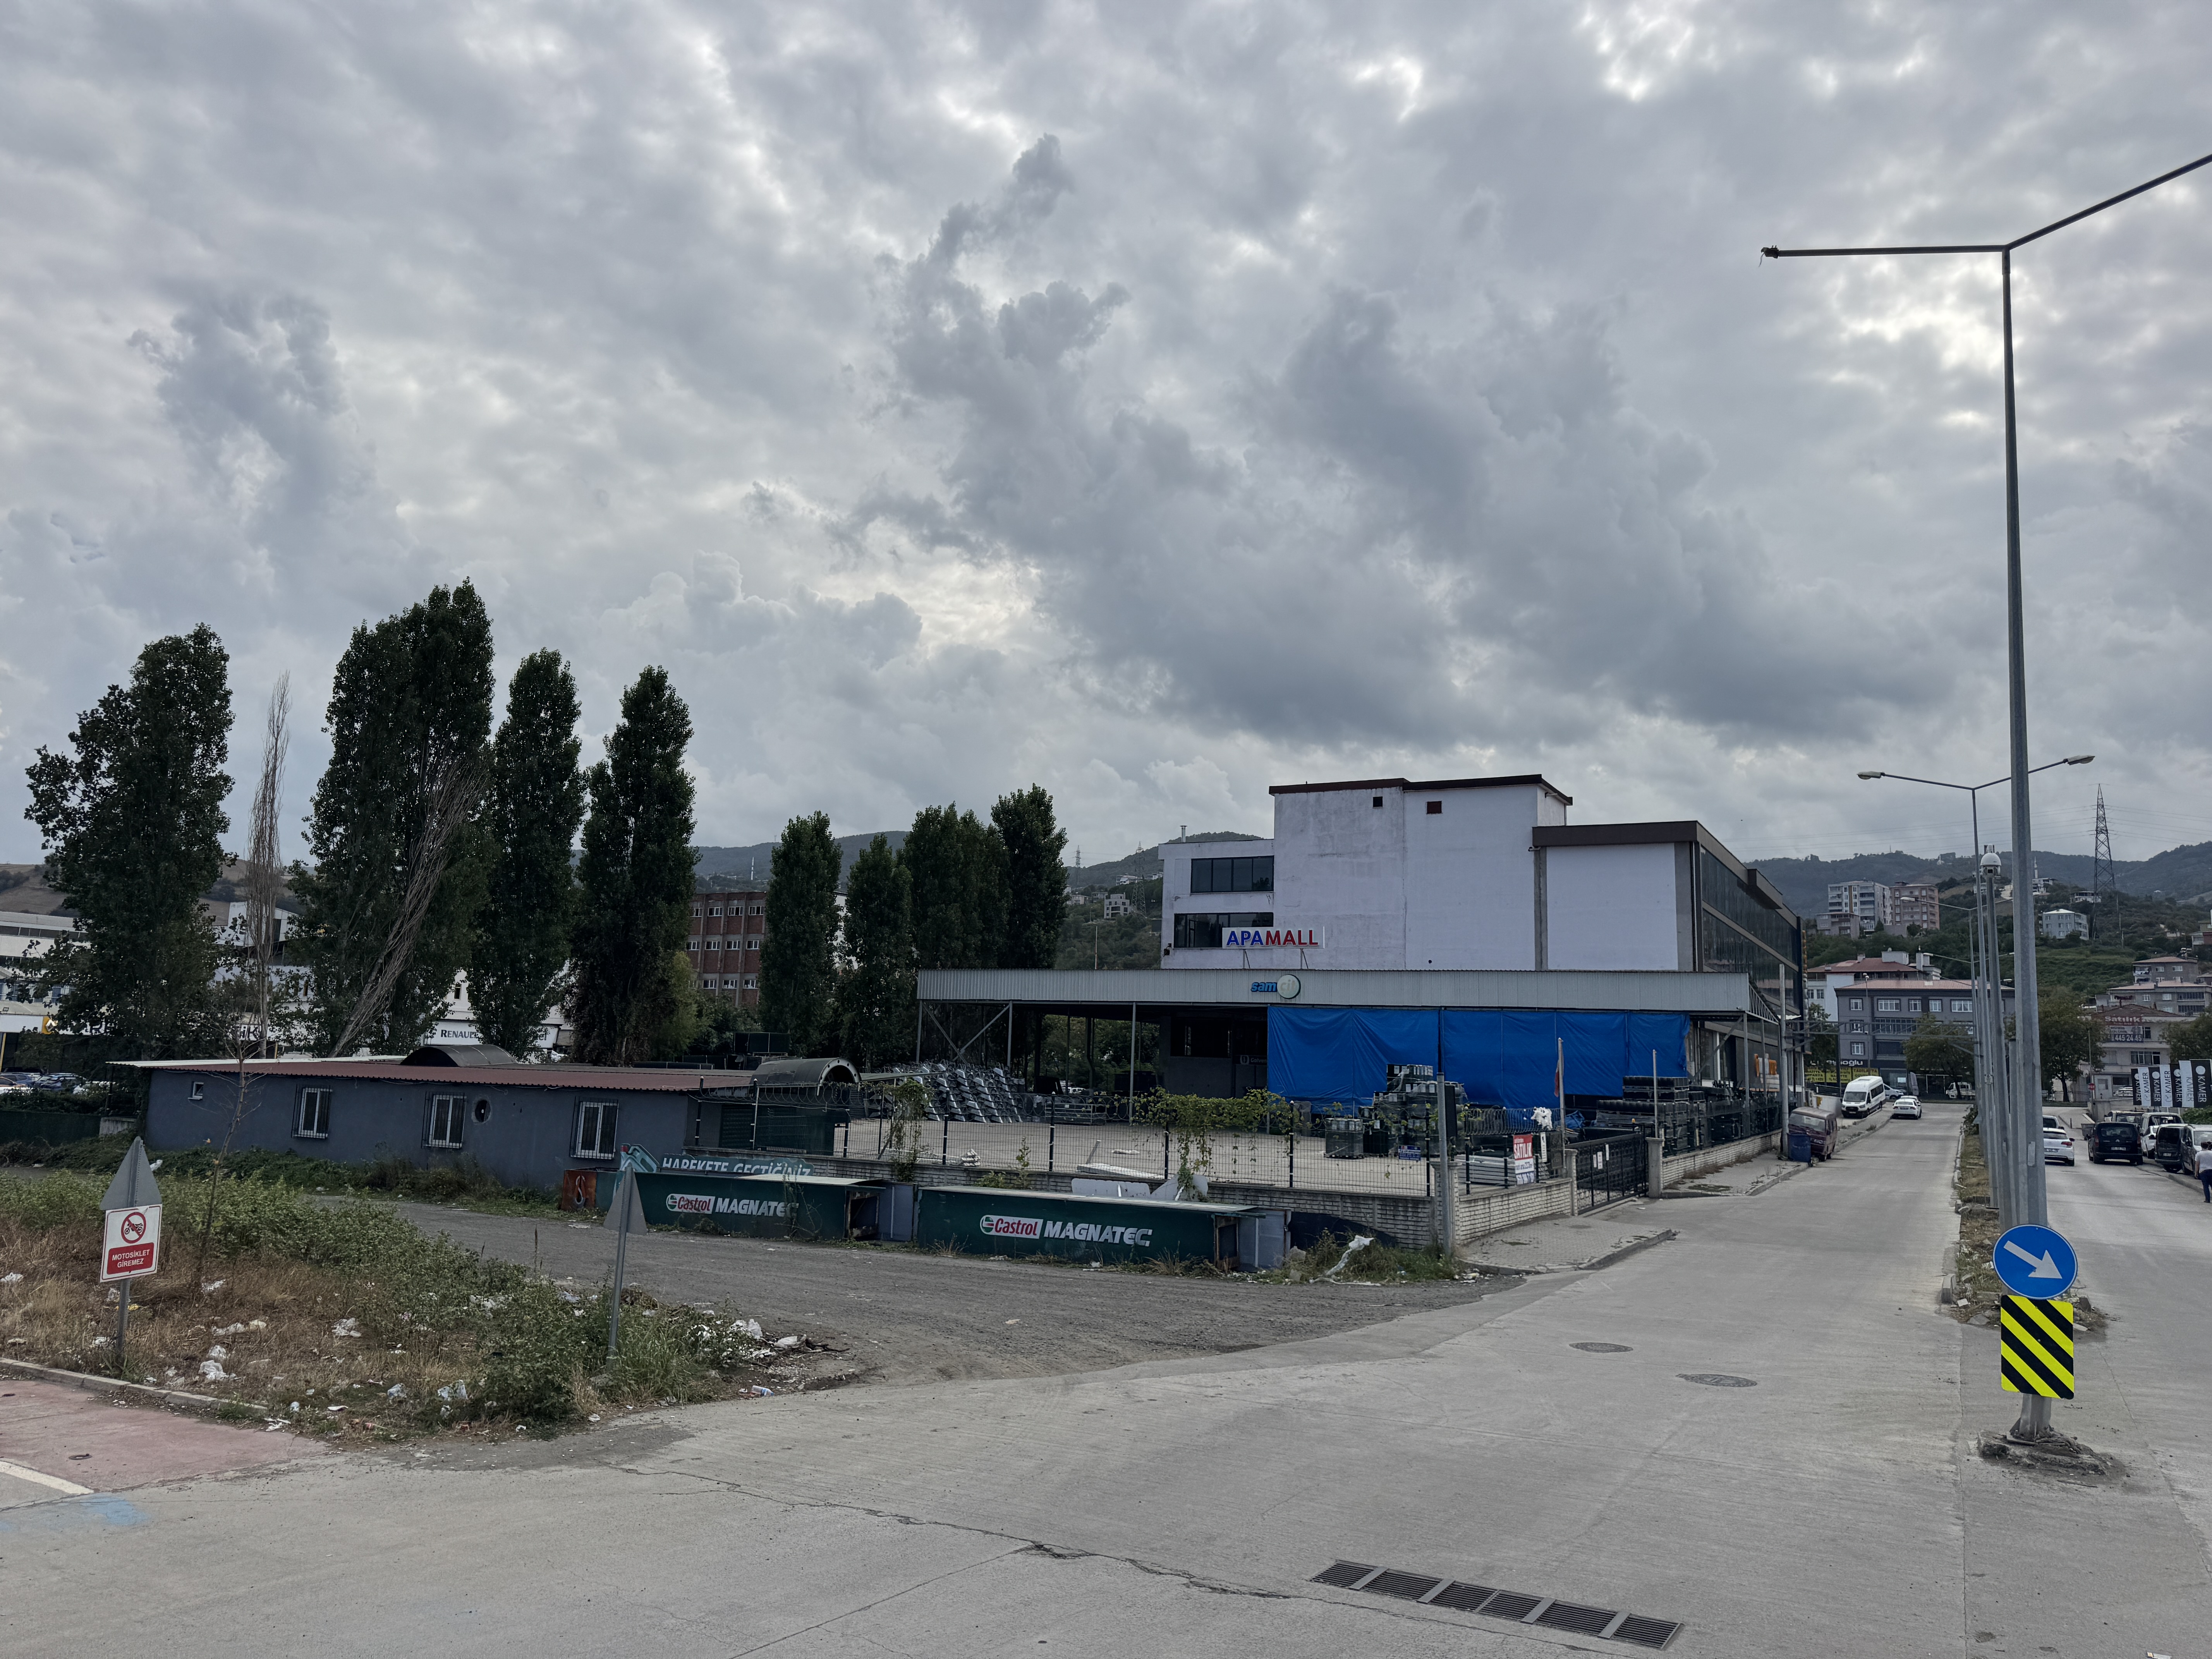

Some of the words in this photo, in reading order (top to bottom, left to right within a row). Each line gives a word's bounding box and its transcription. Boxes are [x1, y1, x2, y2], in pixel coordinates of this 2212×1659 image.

[1226, 930, 1319, 946] APAMALL
[1251, 982, 1277, 992] sam
[2197, 1076, 2207, 1102] KAMER
[677, 1196, 711, 1212] Castrol
[994, 1218, 1039, 1236] Castrol
[1044, 1220, 1153, 1247] MAGNATEC
[112, 1249, 150, 1261] MOTOSİKLET
[117, 1258, 144, 1268] GİREMEZ
